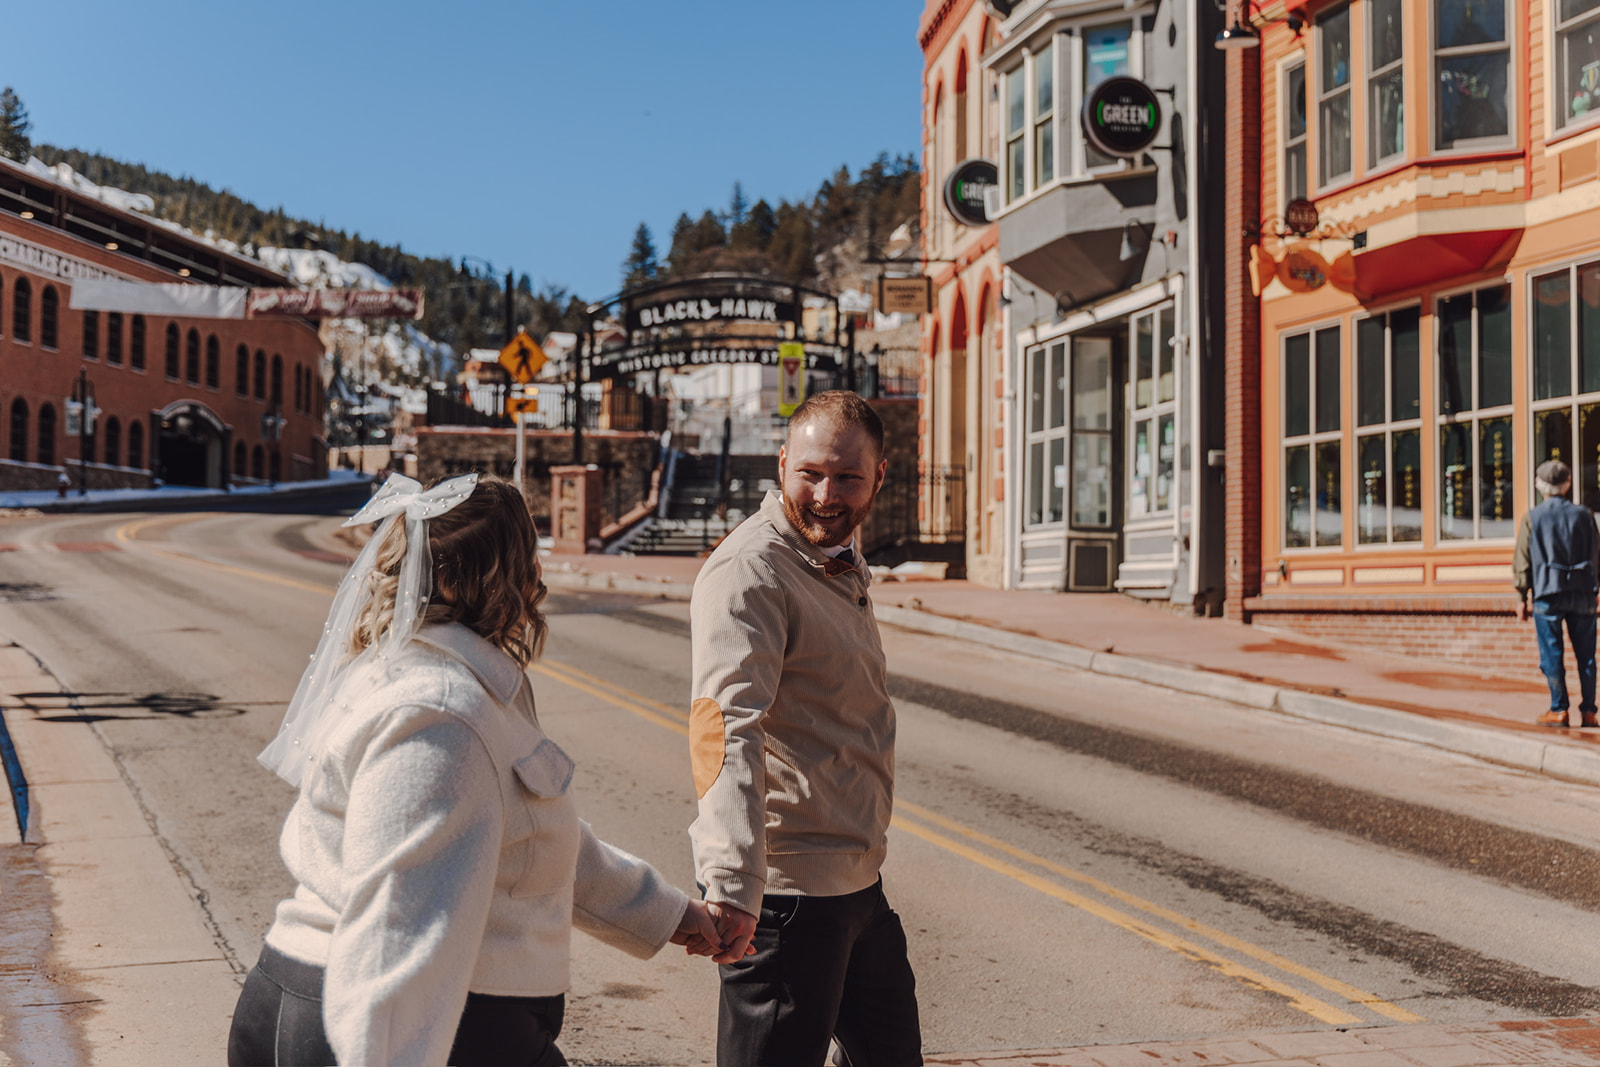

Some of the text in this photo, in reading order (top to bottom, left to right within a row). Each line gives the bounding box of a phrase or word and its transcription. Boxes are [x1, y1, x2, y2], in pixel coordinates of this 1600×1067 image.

[1103, 104, 1149, 125] GREEN
[639, 298, 777, 327] BLACK HAWK
[617, 351, 686, 375] HISTORIC
[690, 349, 757, 364] GREGORY
